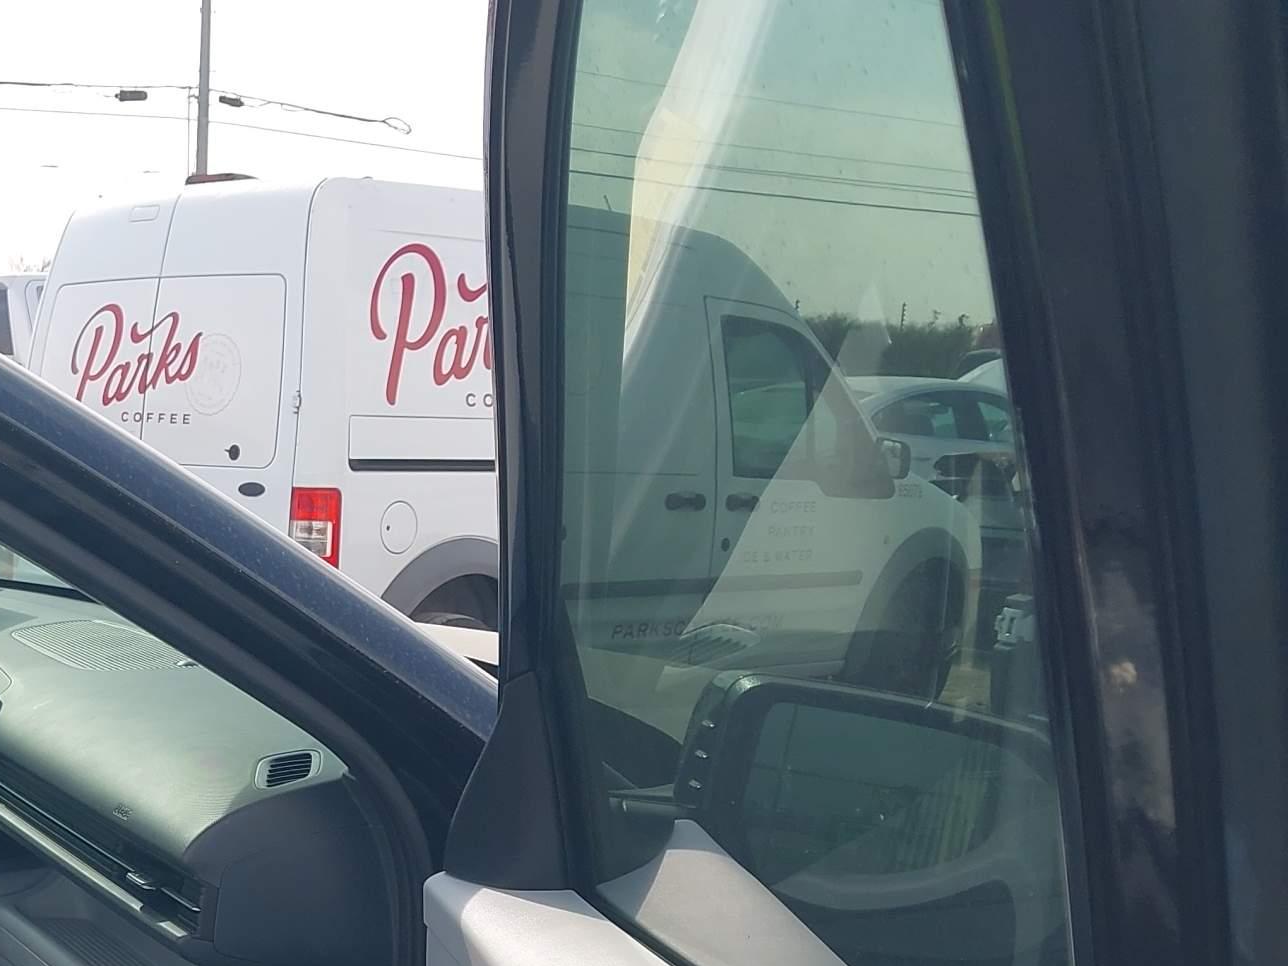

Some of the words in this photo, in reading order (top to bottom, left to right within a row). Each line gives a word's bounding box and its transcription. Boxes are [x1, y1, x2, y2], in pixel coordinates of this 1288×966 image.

[71, 303, 204, 407] Parks
[120, 411, 192, 425] COFFEE
[770, 500, 817, 513] COFFEE
